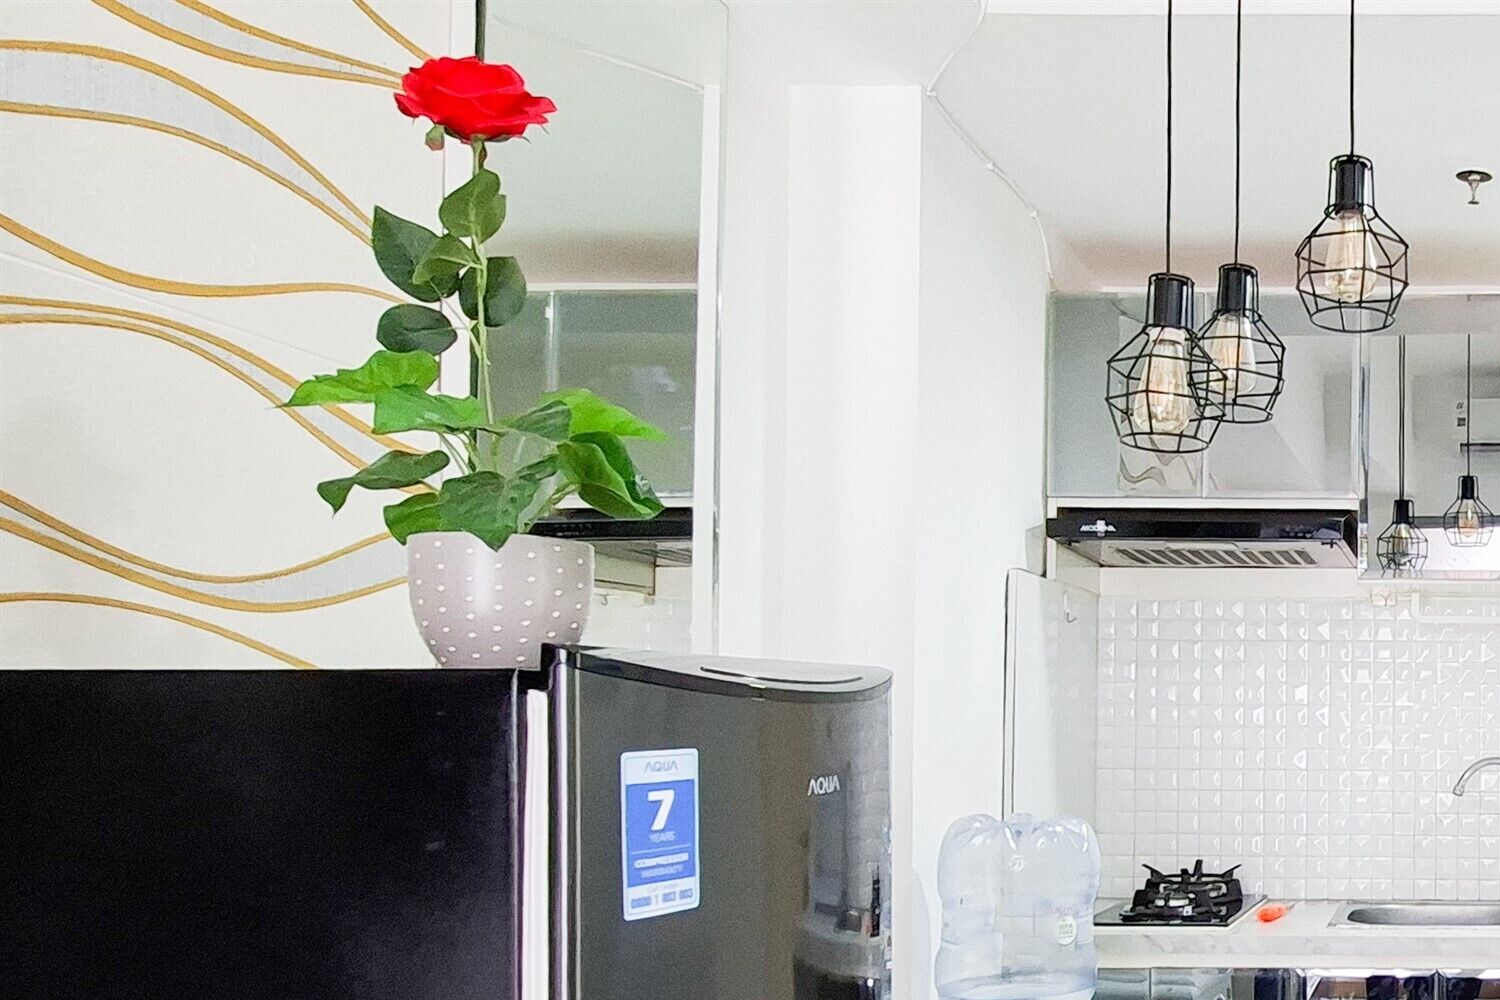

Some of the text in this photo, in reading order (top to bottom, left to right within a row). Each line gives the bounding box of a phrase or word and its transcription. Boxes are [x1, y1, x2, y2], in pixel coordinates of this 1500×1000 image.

[644, 760, 679, 773] AQUA
[807, 774, 840, 797] AQUA
[647, 789, 676, 831] 7
